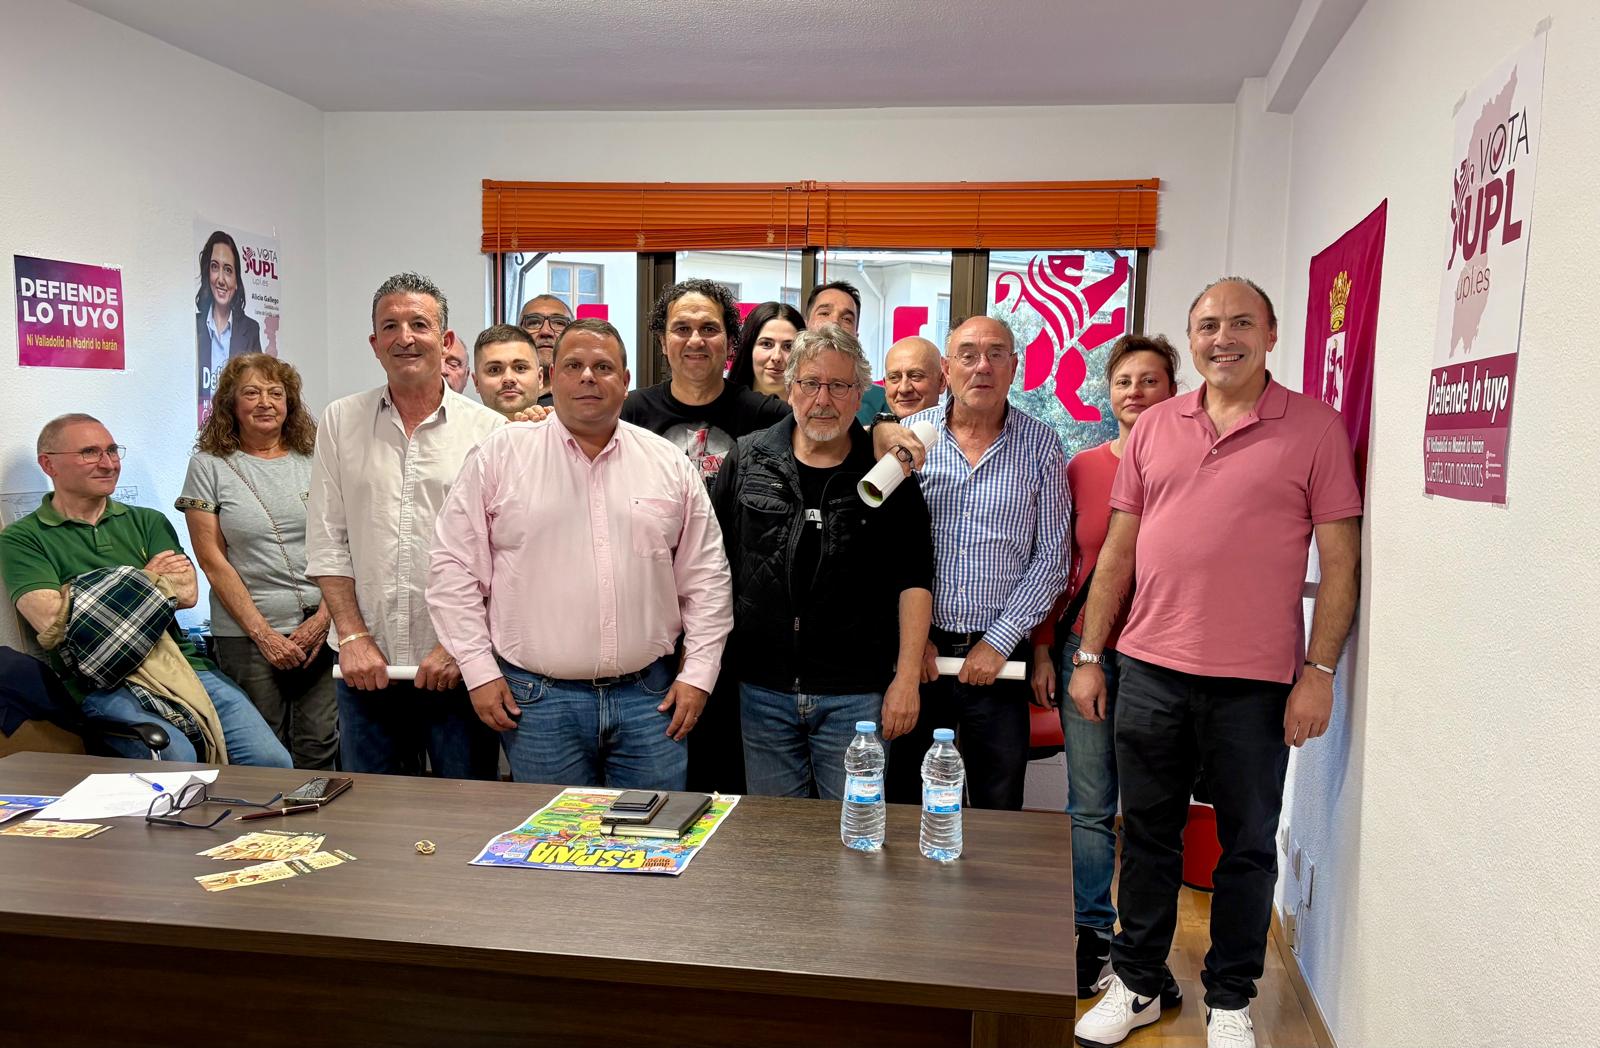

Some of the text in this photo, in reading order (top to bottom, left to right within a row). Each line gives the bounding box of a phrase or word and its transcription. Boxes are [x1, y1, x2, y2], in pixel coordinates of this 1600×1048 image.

[1480, 105, 1529, 183] VOTA
[1462, 168, 1522, 261] UPL
[251, 258, 278, 280] UPL
[257, 247, 278, 263] VOTA
[20, 277, 119, 306] DEFIENDE
[1456, 267, 1491, 304] upl.es
[23, 300, 119, 330] LO TUYO
[26, 333, 118, 351] Ni Valladolid ni Madrid lo harán
[1428, 364, 1509, 424] Defiende lo tuyo
[1426, 454, 1484, 488] Cuenta con nosotros
